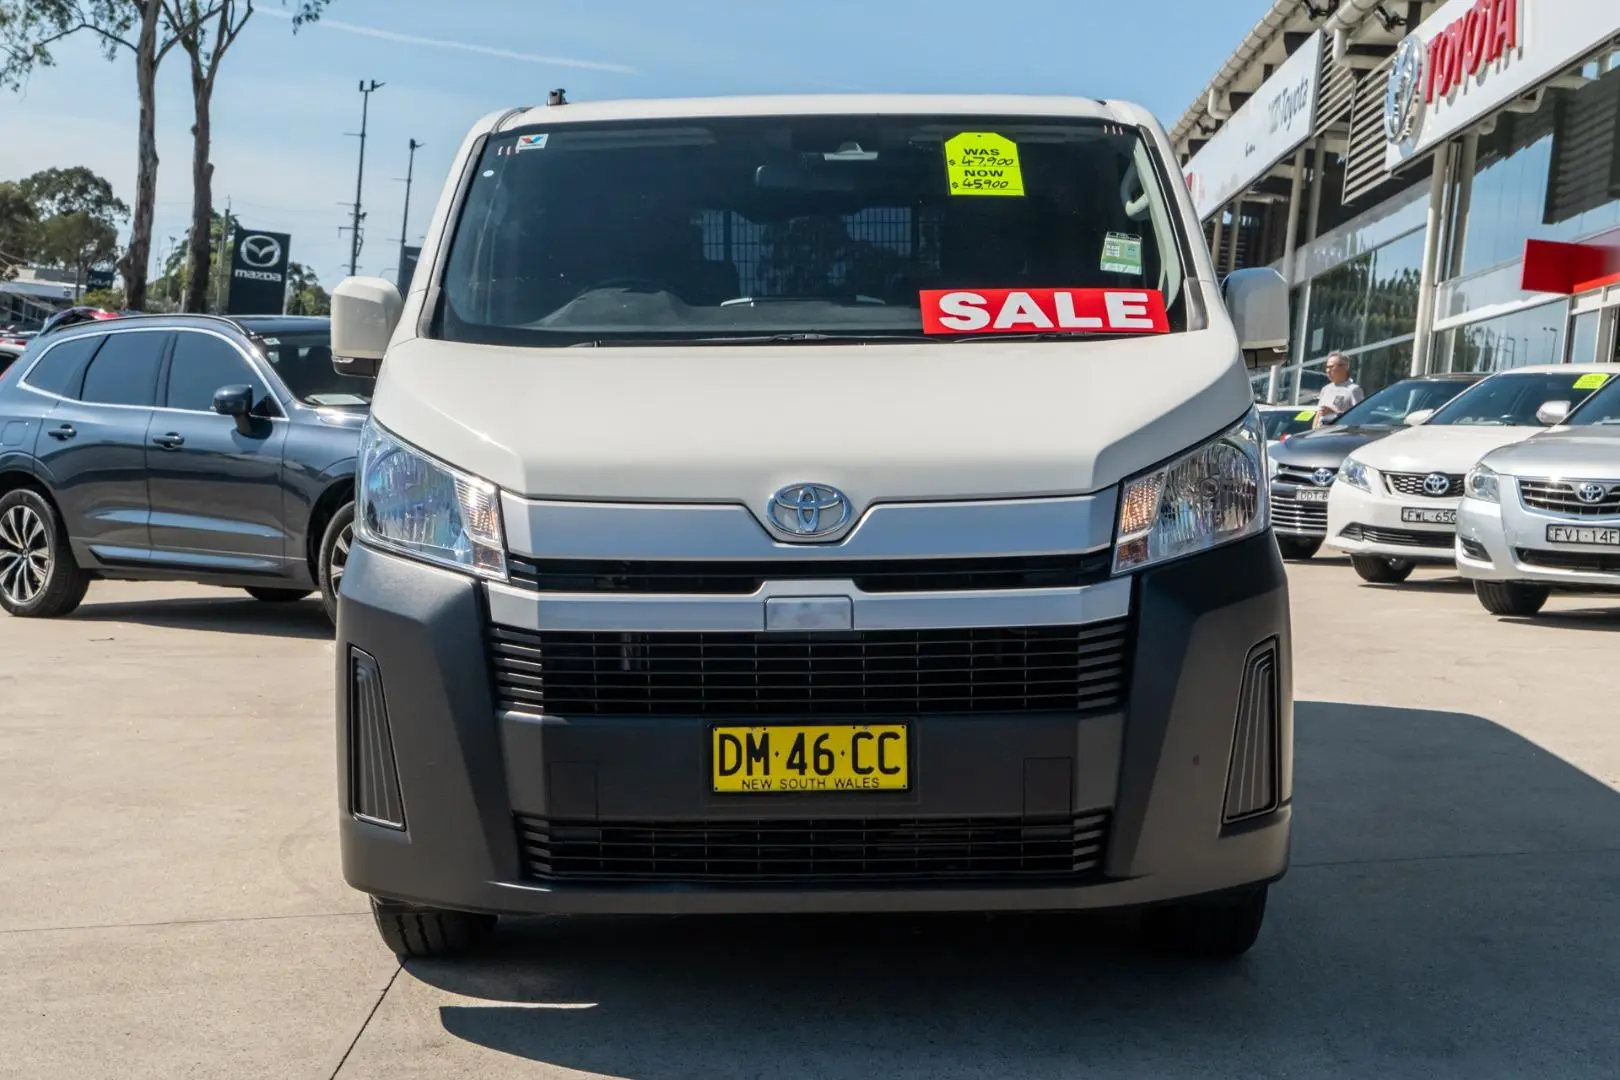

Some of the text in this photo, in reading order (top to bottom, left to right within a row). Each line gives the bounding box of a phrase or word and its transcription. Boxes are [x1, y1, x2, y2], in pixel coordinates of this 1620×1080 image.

[1425, 0, 1517, 104] TOYOTA
[963, 148, 1001, 156] WAS
[963, 169, 1004, 177] NOW
[235, 268, 282, 282] mazda
[938, 291, 1154, 330] SALE
[742, 777, 880, 790] NEW SOUTH WALES
